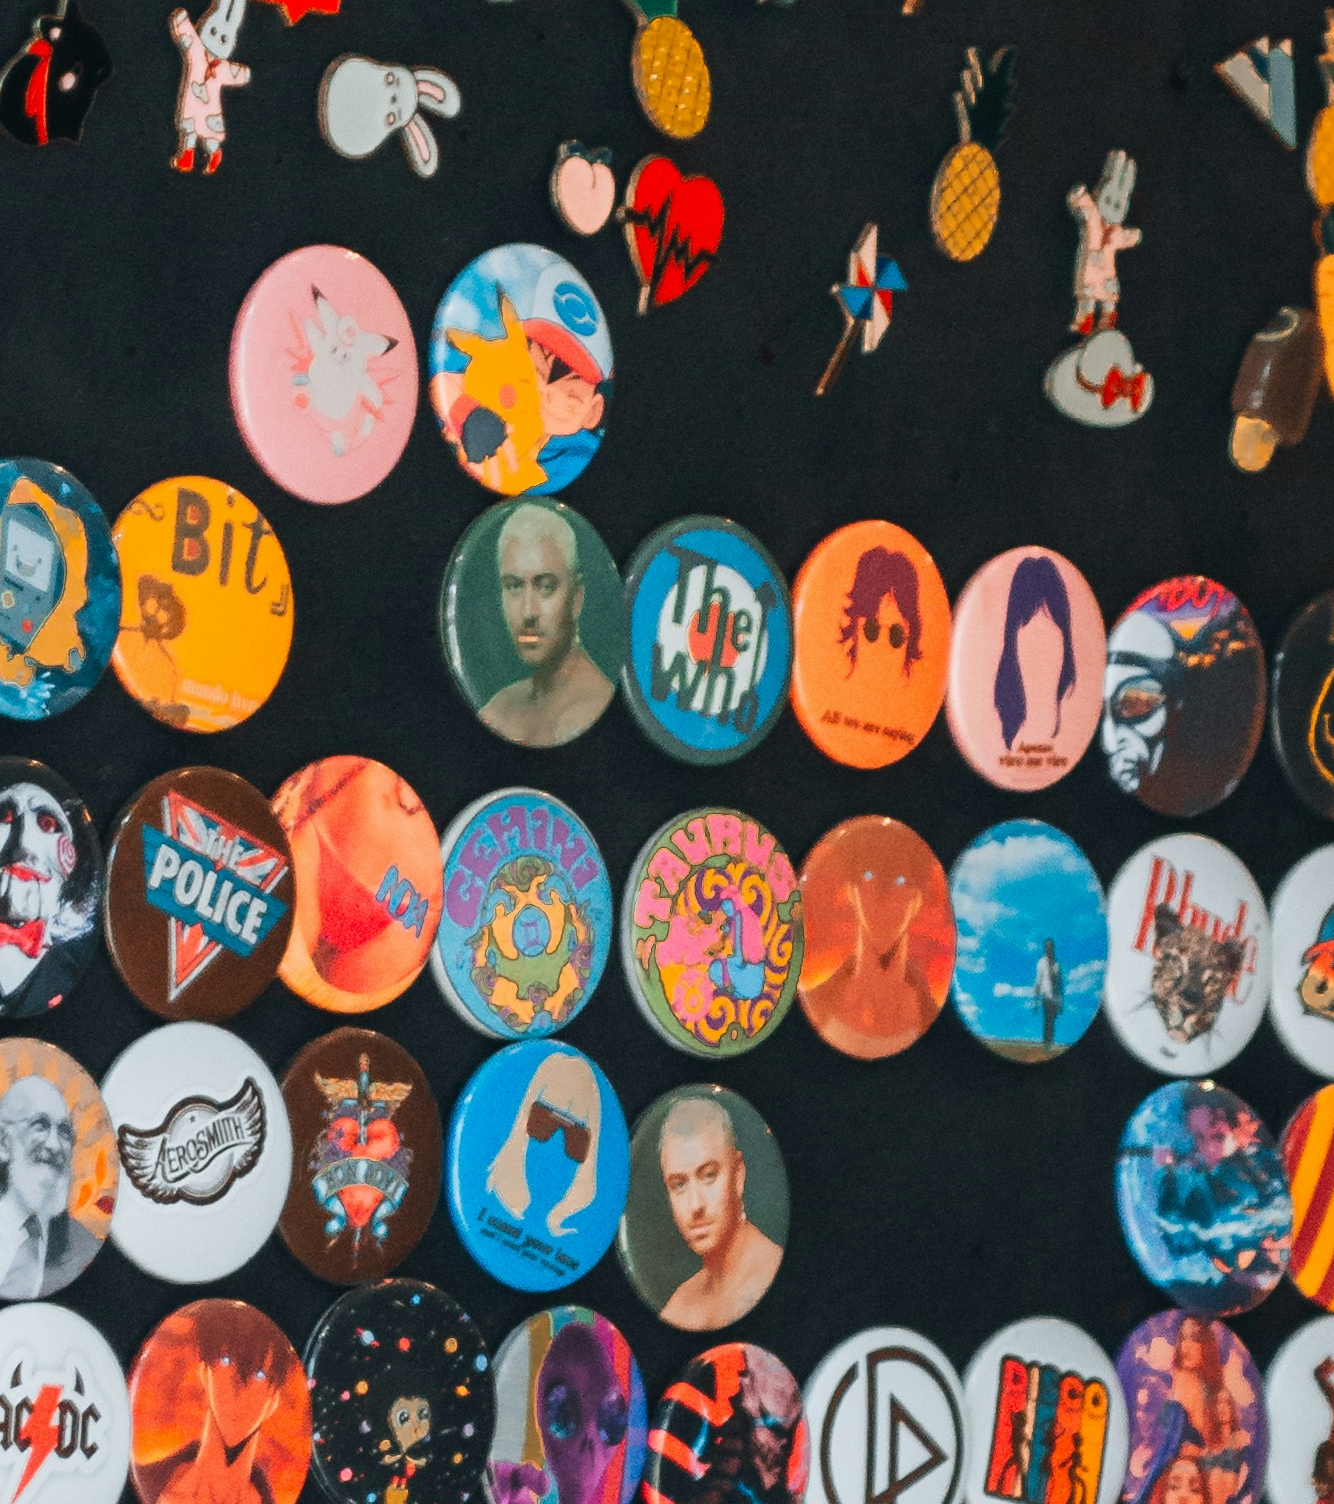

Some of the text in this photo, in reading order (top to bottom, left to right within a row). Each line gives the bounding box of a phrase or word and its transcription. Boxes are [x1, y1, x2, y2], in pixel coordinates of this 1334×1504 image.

[172, 487, 274, 593] Bit
[148, 843, 269, 945] POLICE
[446, 806, 599, 930] GEMINI
[633, 813, 798, 928] TAURUS
[148, 1116, 246, 1183] AEROSMITH
